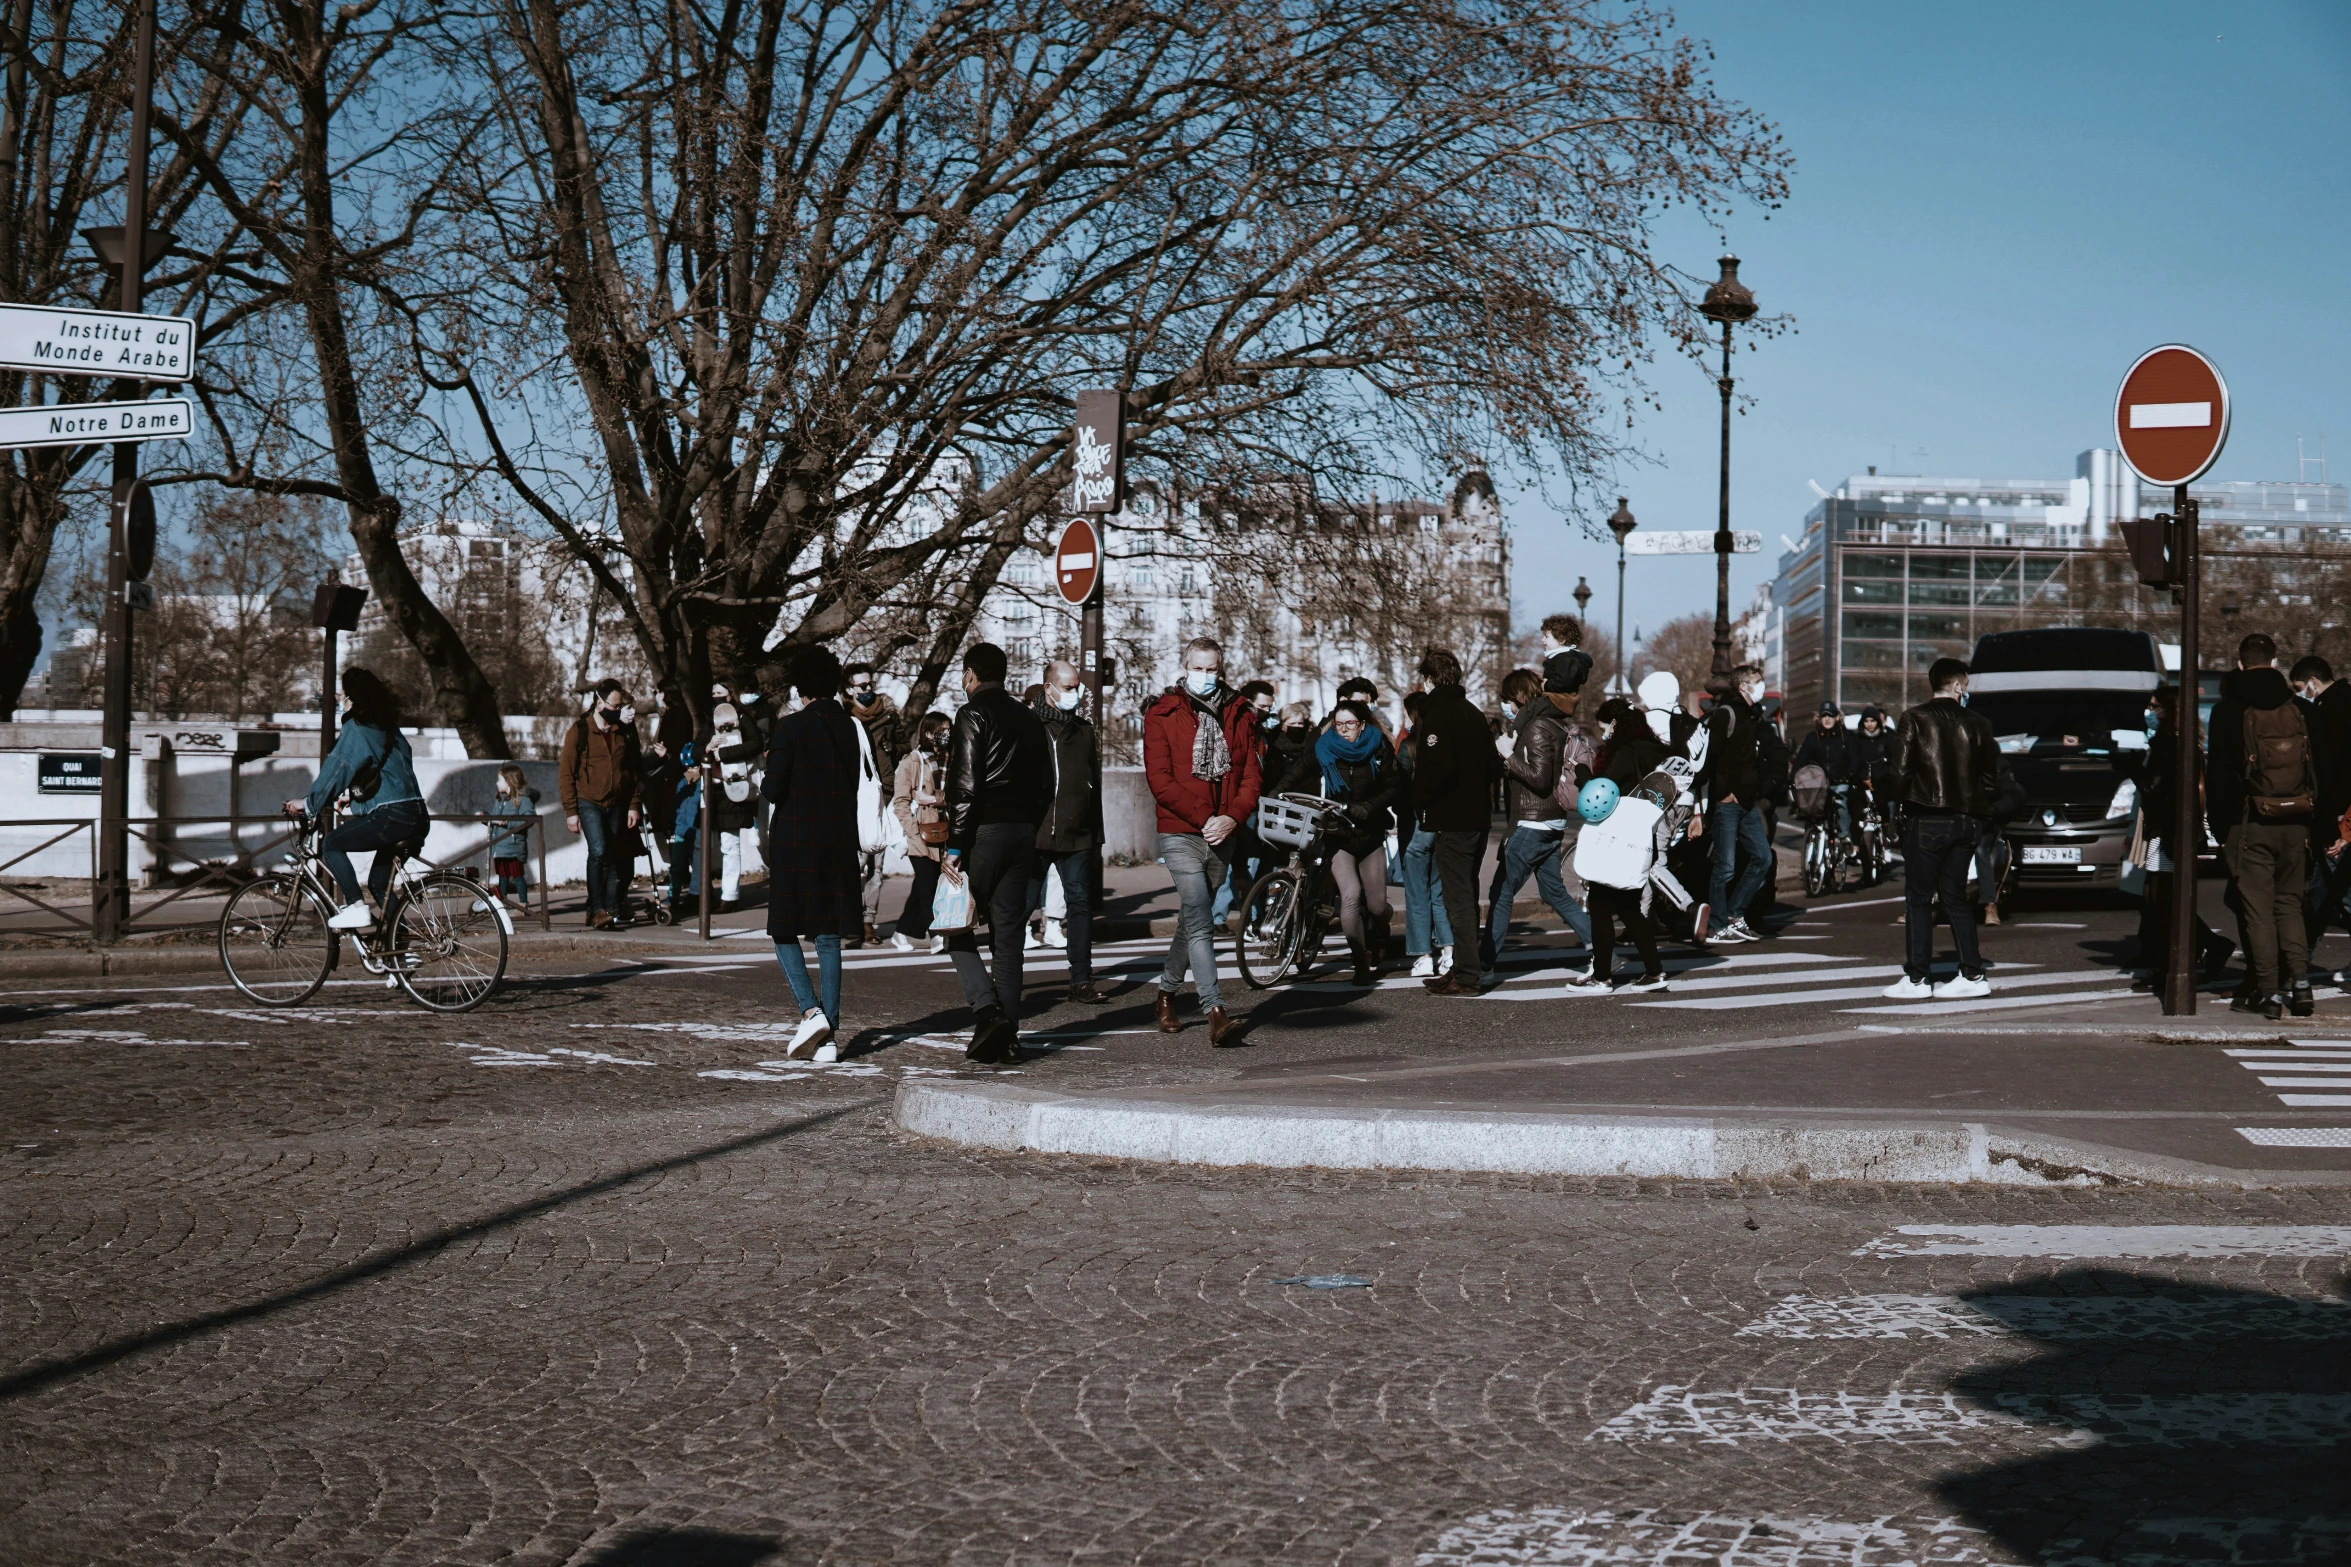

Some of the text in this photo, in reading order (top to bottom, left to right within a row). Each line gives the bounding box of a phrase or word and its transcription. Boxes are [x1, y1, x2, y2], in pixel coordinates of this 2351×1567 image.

[60, 320, 180, 345] Institut du
[34, 341, 179, 367] Monde Arabe
[49, 412, 179, 433] Notre Dame
[63, 763, 82, 772] QUAI
[42, 777, 102, 786] SAINT BERNARD
